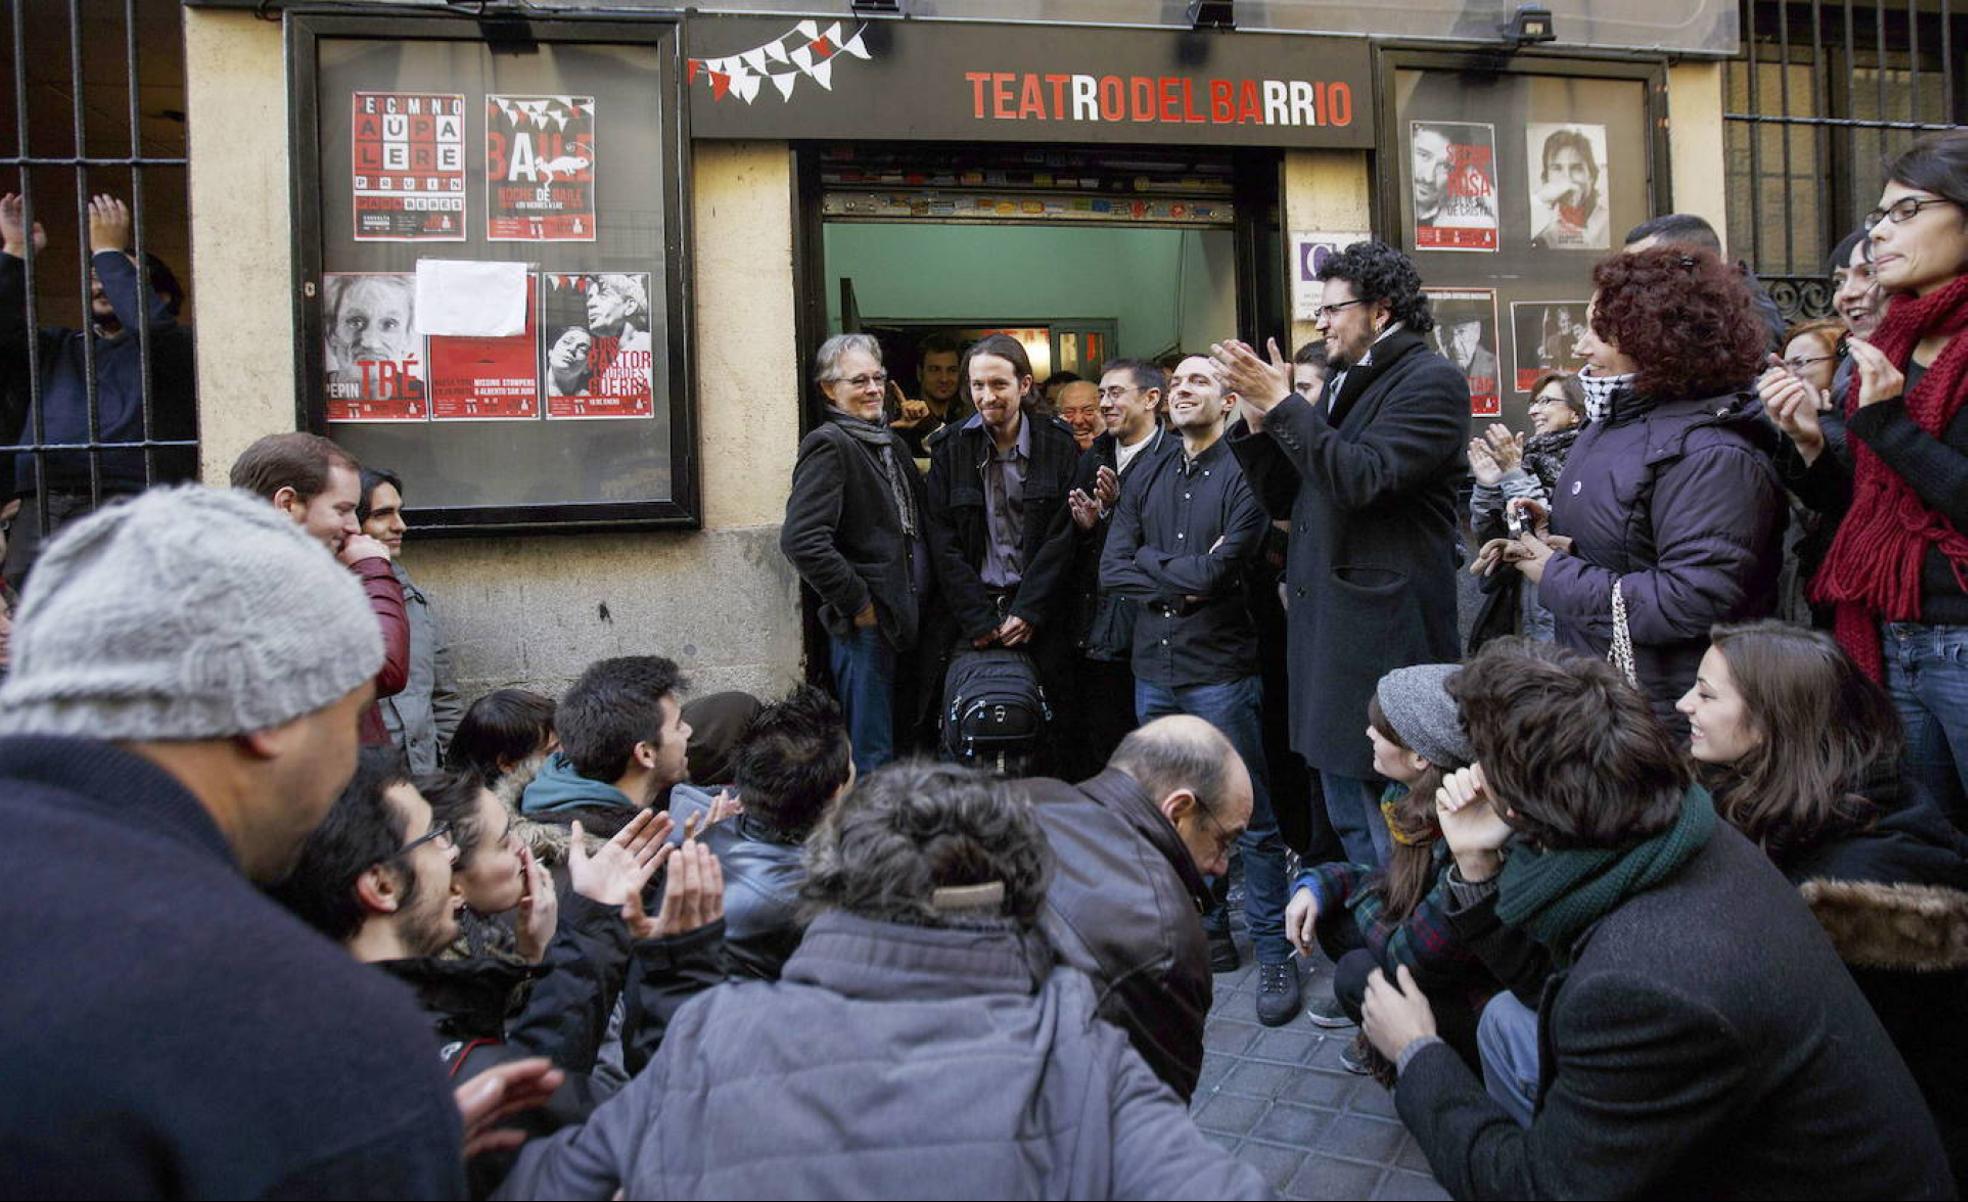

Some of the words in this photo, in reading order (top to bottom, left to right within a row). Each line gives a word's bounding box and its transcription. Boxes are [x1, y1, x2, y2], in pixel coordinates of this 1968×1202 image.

[965, 71, 1125, 122] TEATRO
[1131, 76, 1205, 123] DEL
[1210, 80, 1353, 128] BARRIO
[536, 187, 550, 201] DE
[588, 350, 651, 369] PASTOR
[357, 353, 418, 399] TRÉ
[588, 377, 650, 395] GUERRA
